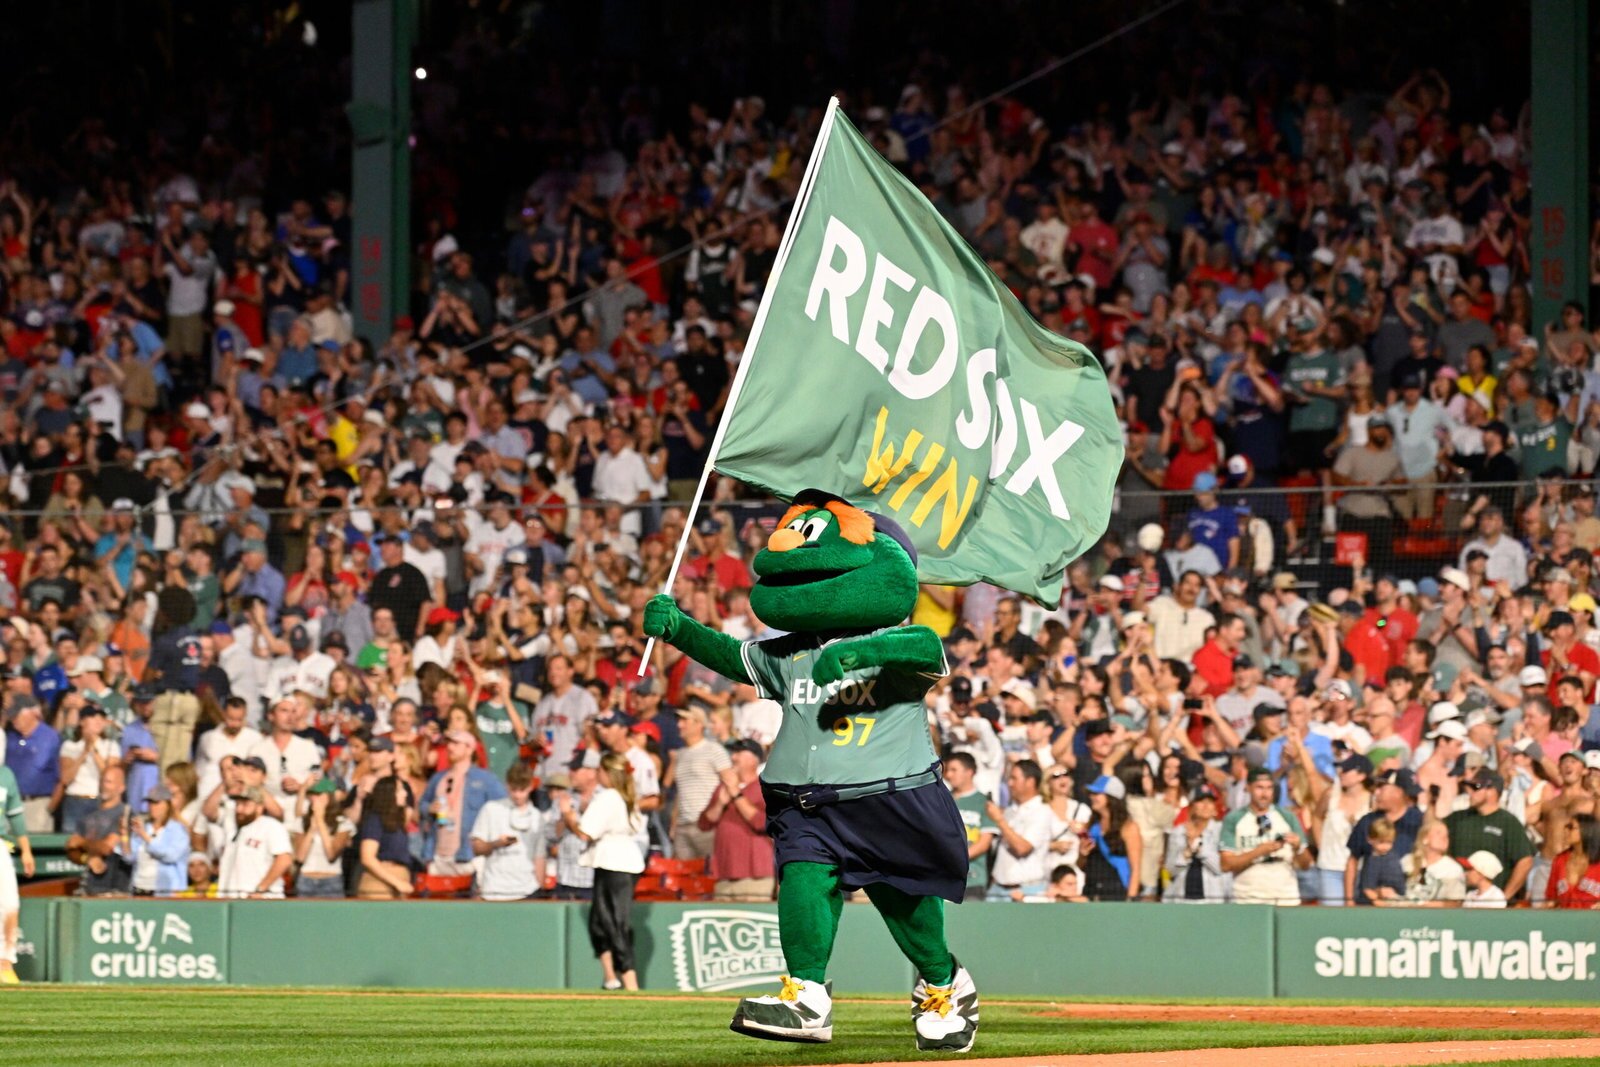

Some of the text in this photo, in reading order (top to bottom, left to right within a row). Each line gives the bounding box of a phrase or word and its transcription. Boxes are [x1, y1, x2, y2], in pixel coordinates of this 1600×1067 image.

[804, 214, 1086, 521] RED SOX
[862, 405, 979, 551] WIN
[791, 678, 876, 706] ED SOX
[832, 716, 877, 747] 97
[91, 911, 157, 952] city
[702, 919, 781, 955] ACE
[90, 946, 218, 979] cruises
[704, 955, 783, 978] TICKET
[1314, 929, 1596, 981] smartwater
